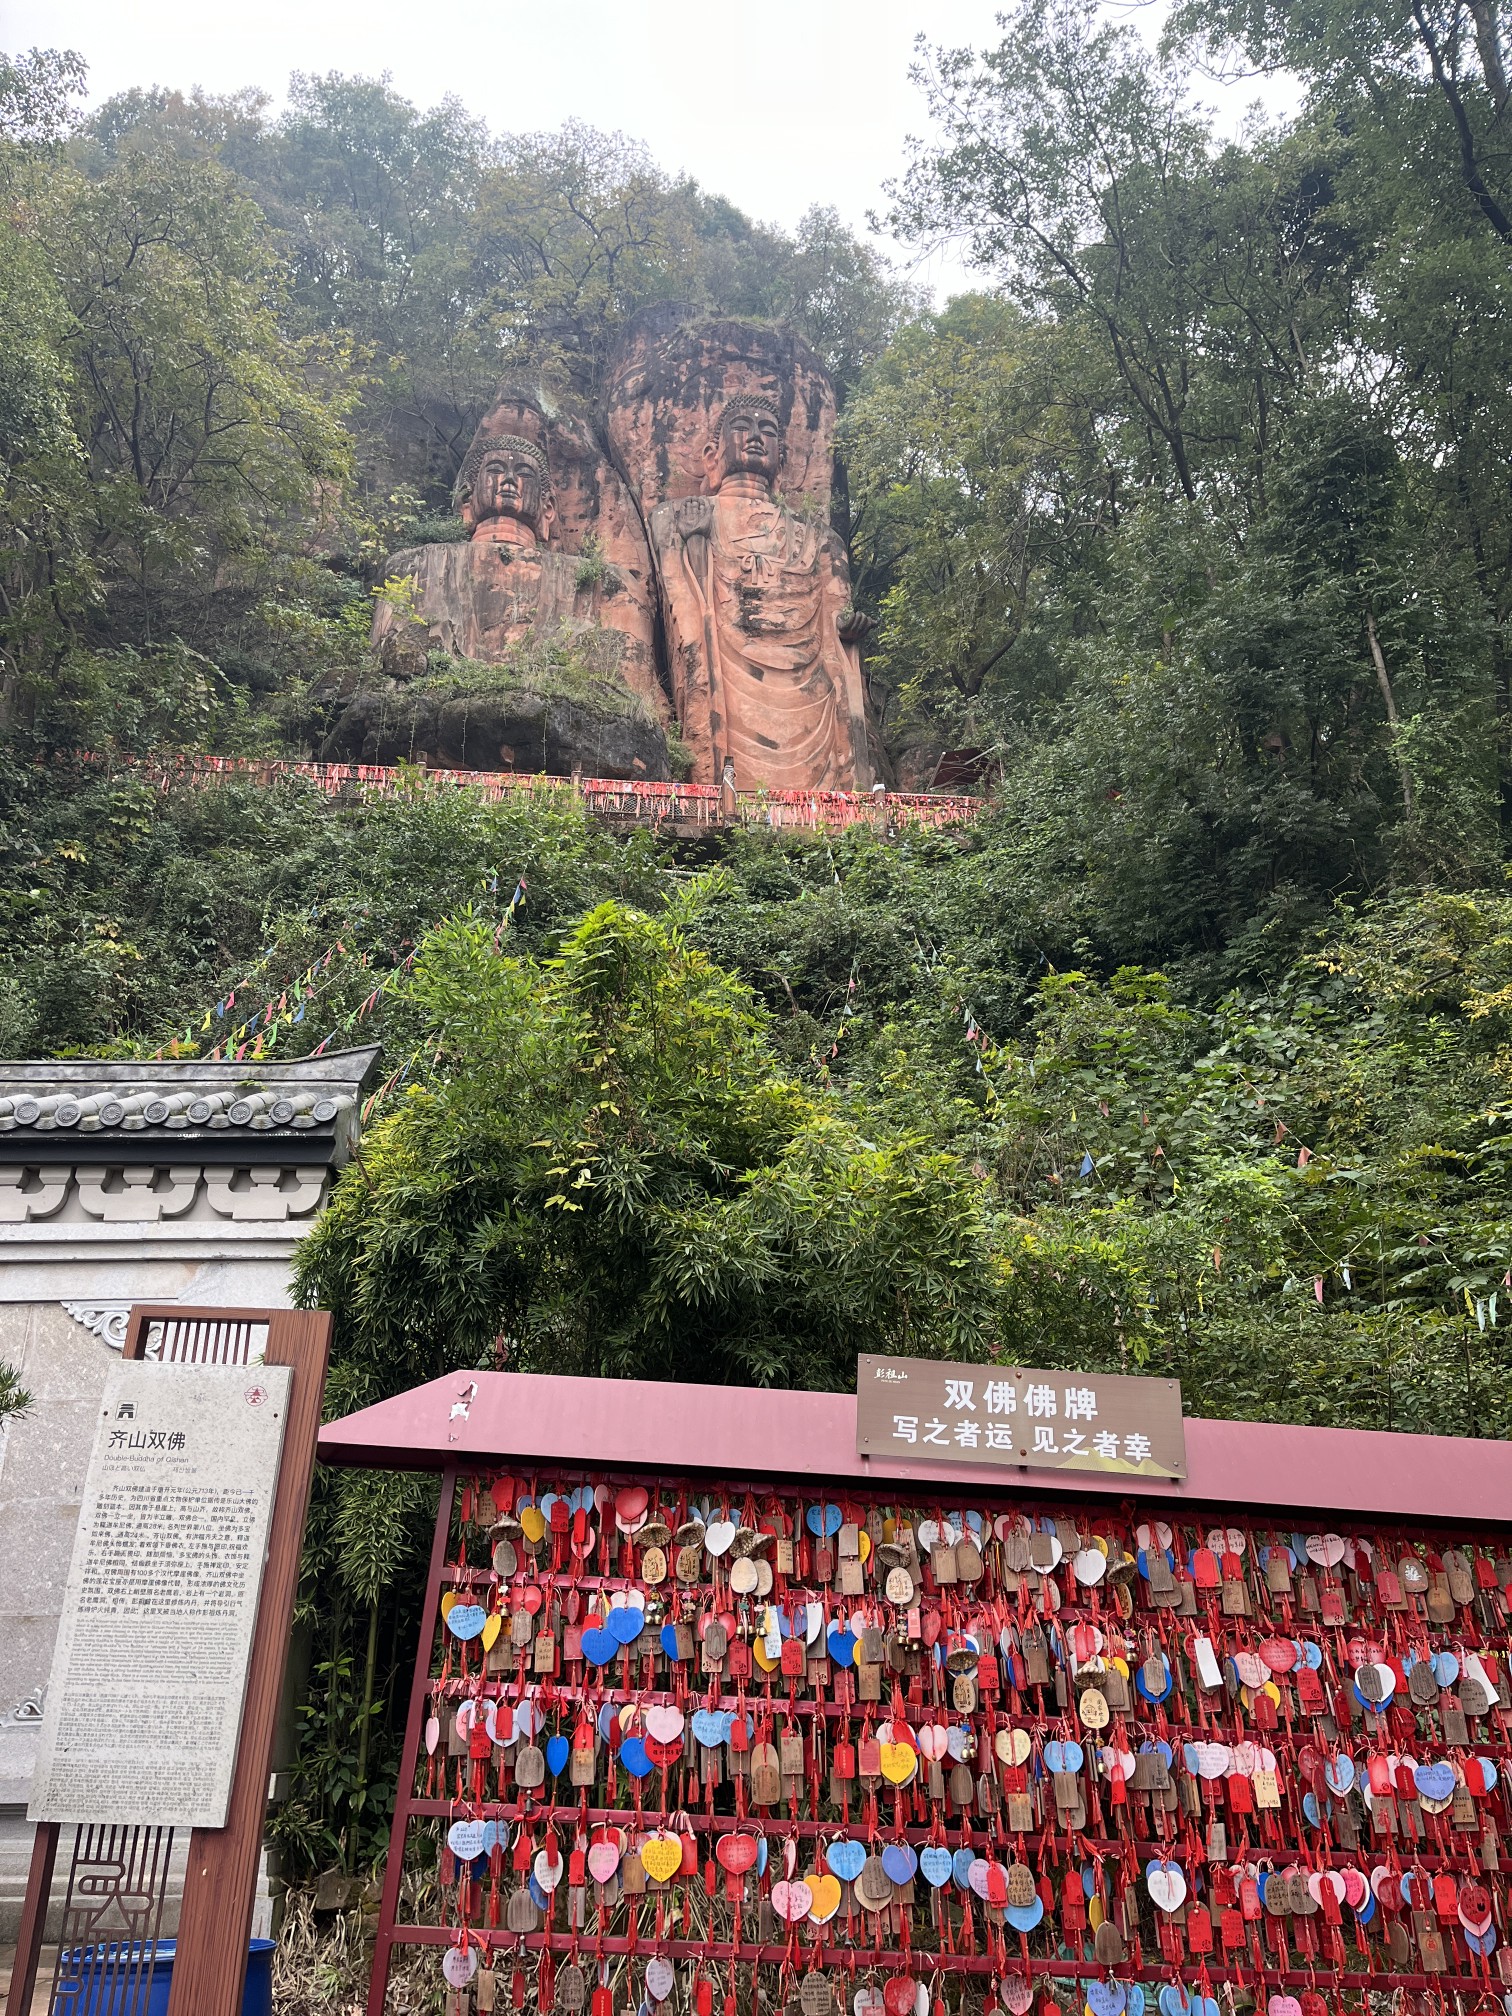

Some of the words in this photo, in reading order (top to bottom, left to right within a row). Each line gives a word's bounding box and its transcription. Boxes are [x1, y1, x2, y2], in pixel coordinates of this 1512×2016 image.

[874, 1368, 908, 1379] 彭祖山
[943, 1379, 1099, 1421] 双佛佛牌
[108, 1430, 186, 1451] 齐山双佛
[892, 1415, 1014, 1450] 写之者运
[1032, 1426, 1152, 1461] 见之者幸
[104, 1454, 155, 1462] Double-Buddha
